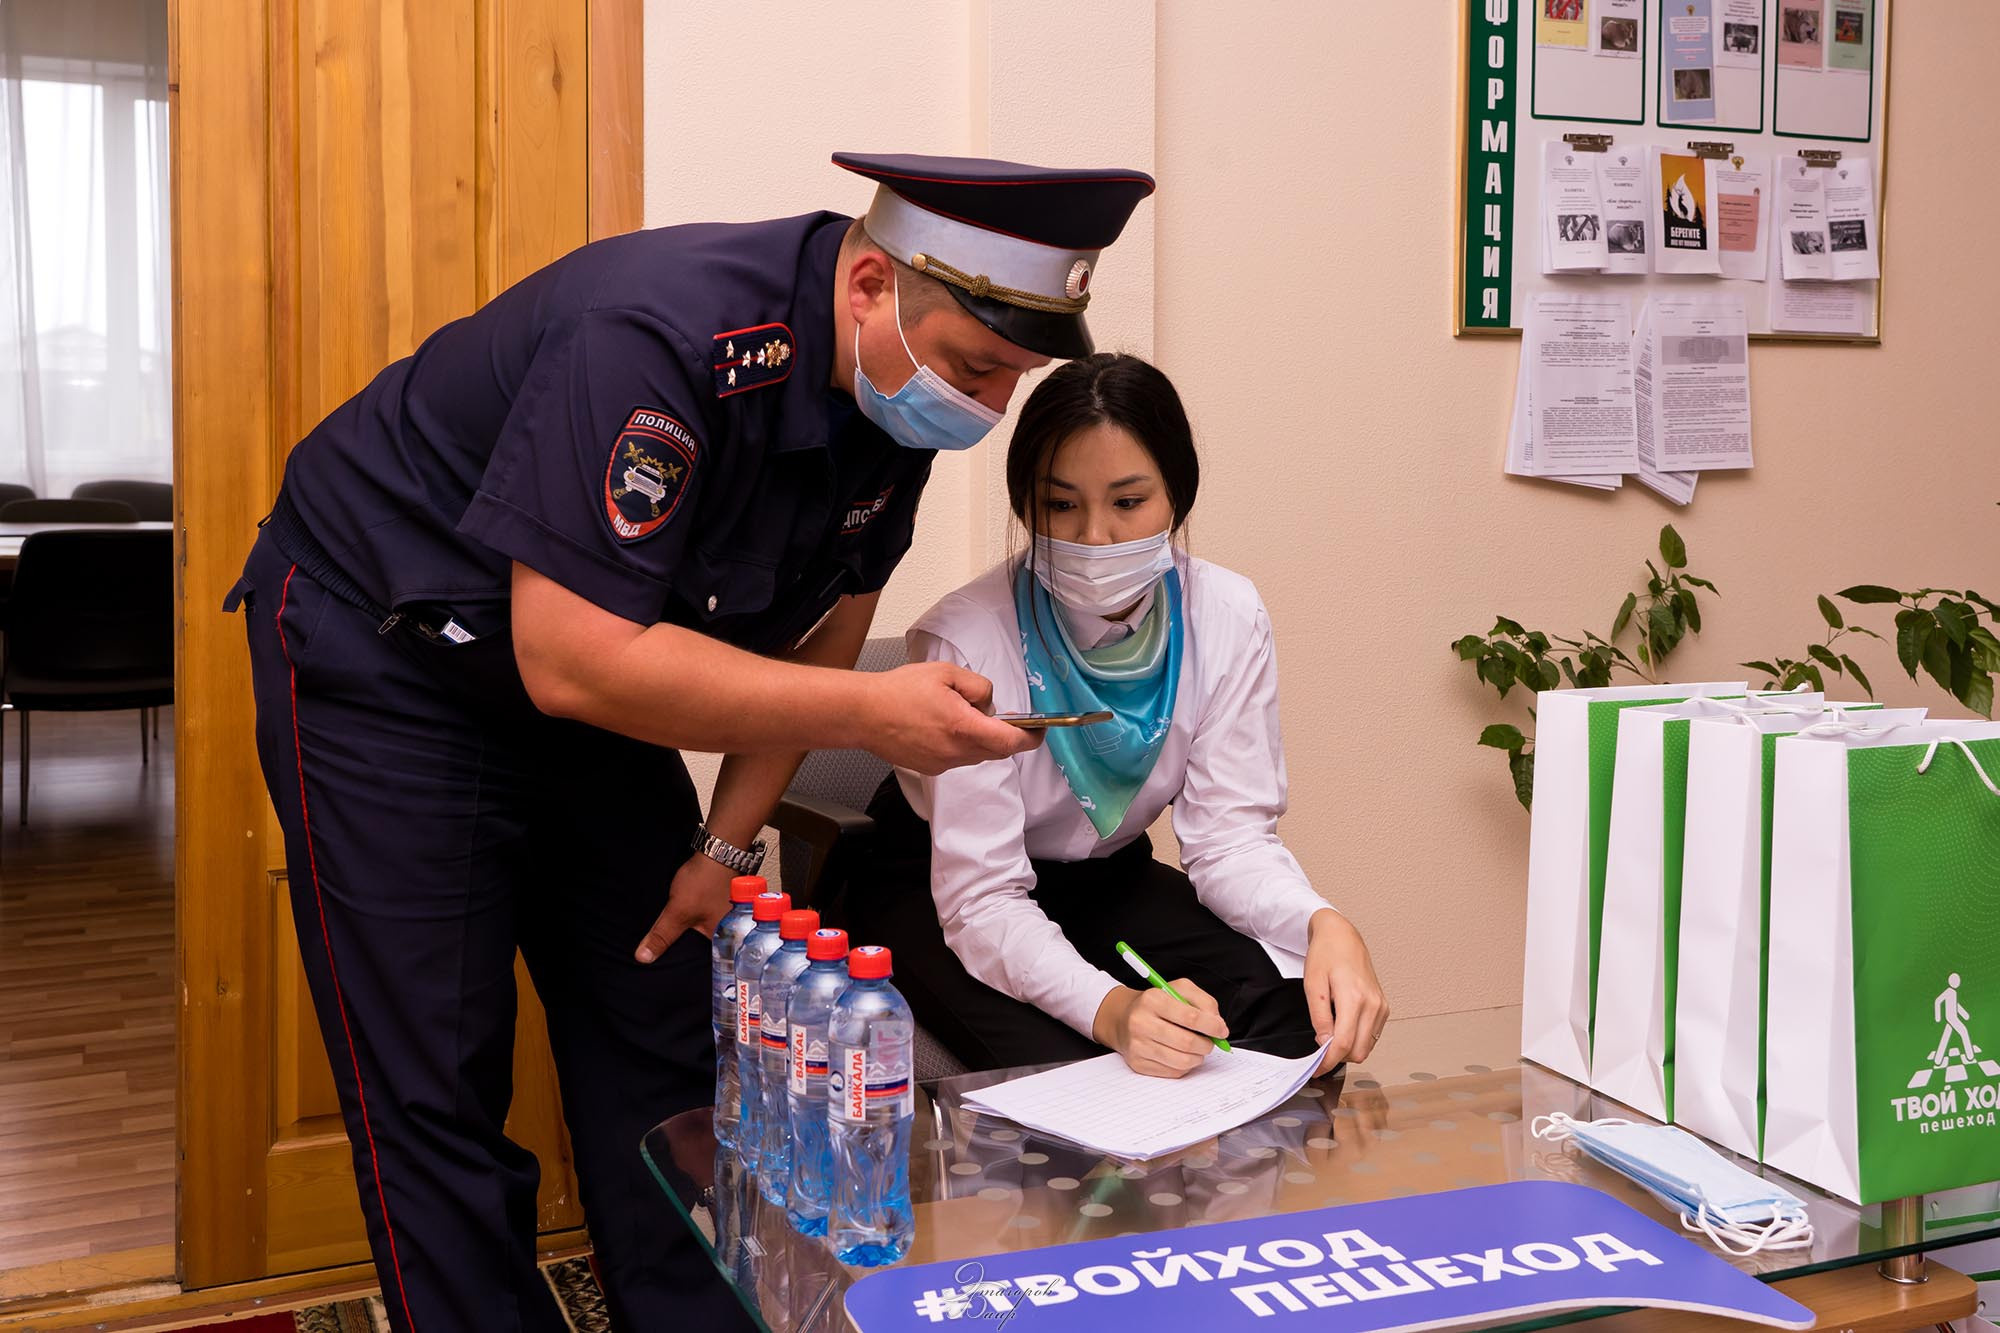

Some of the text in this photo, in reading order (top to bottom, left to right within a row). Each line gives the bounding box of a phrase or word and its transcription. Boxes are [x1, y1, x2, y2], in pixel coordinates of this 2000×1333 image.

[634, 413, 695, 452] ПОЛИЦИЯ
[613, 514, 642, 537] МВД
[739, 984, 748, 1042] БАЙКАЛА
[795, 1032, 804, 1079] BAIKAL
[852, 1052, 863, 1118] БАЙКАЛА
[1891, 1083, 2000, 1121] ТВОЙ ХО
[1920, 1112, 1996, 1134] пешеход
[913, 1229, 1406, 1322] #ТВОЙХОД
[1230, 1232, 1664, 1317] ПЕШЕХОД
